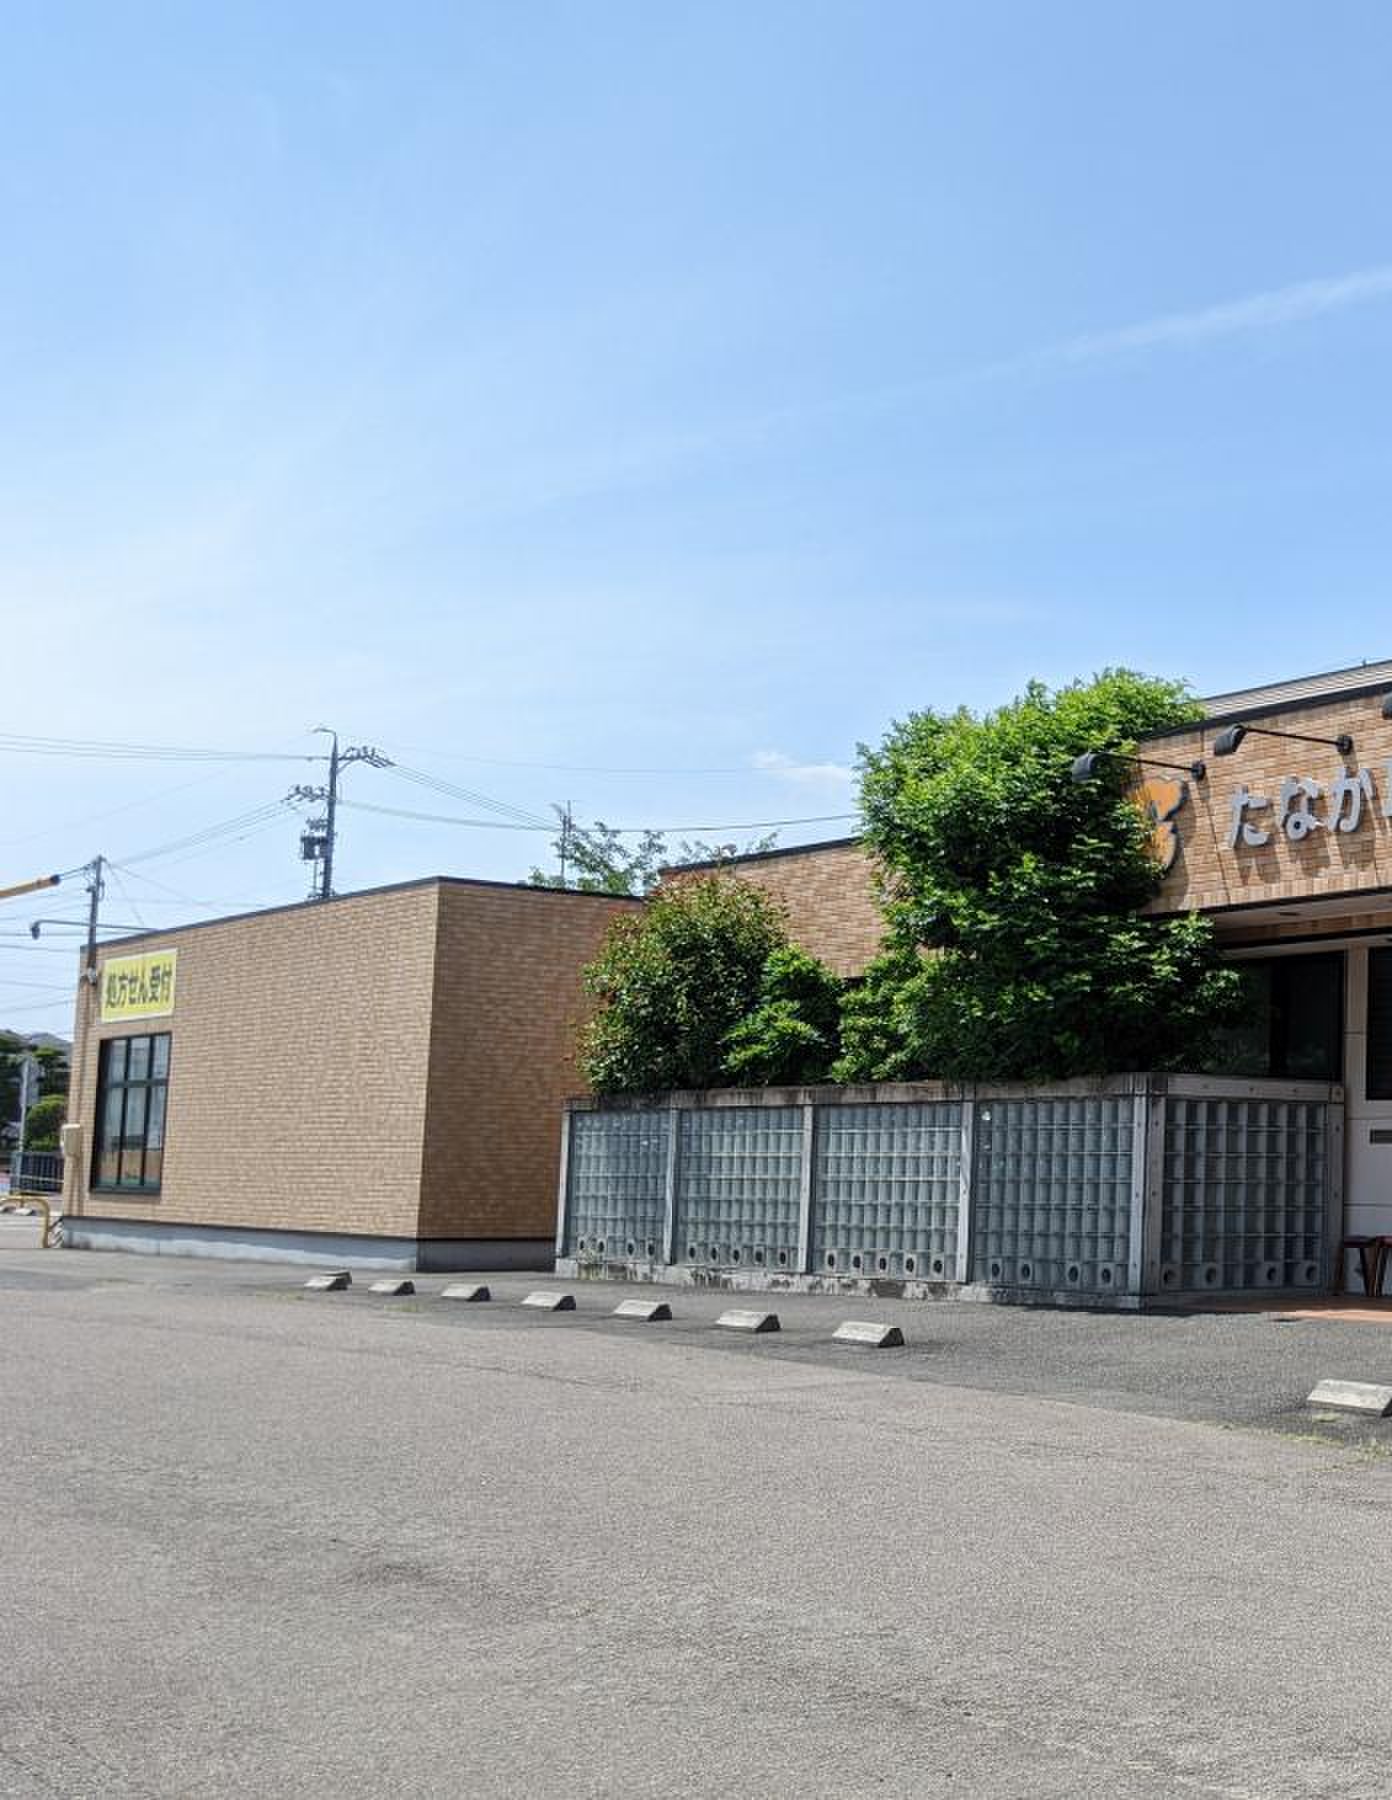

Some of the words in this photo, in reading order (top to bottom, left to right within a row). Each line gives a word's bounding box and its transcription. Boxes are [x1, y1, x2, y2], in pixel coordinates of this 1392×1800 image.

[106, 963, 172, 1008] 処方せん受付
